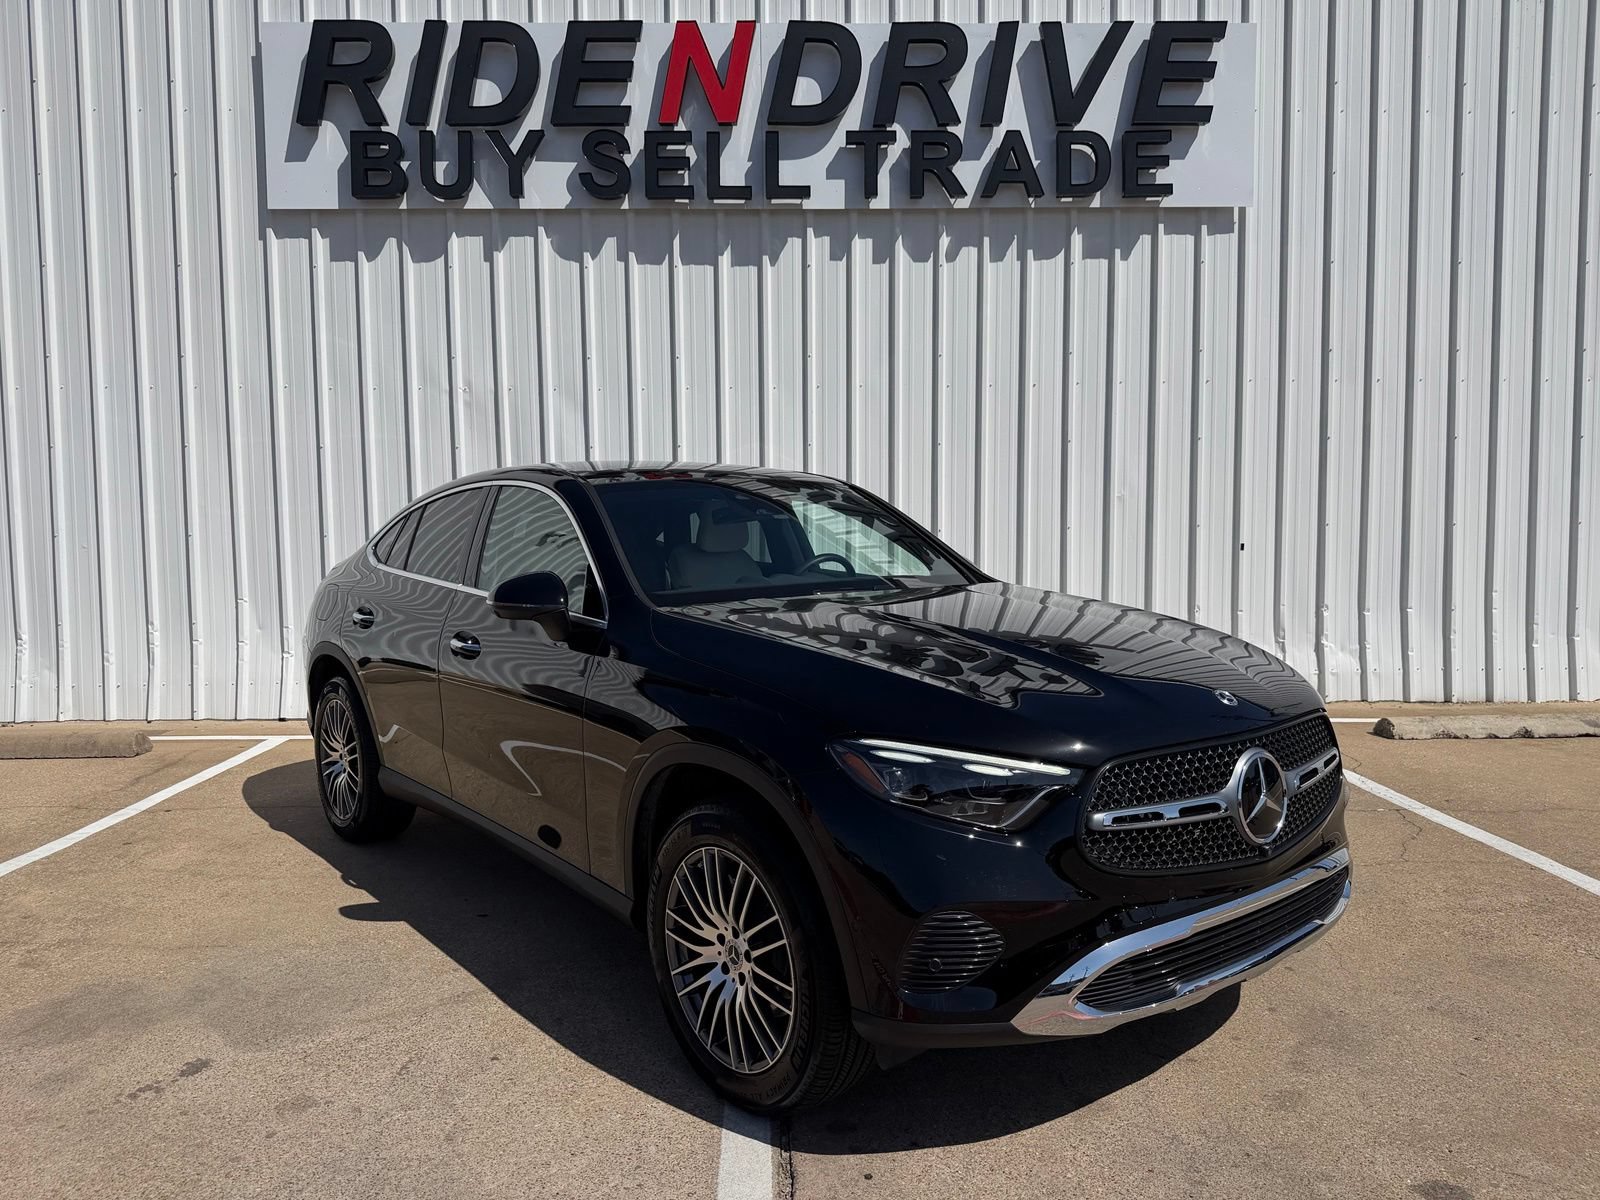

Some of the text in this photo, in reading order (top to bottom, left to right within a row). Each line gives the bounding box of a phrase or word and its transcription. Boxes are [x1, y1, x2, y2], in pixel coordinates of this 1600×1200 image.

[349, 129, 1174, 200] BUY SELL TRADE
[791, 974, 811, 1070] MICHELIN
